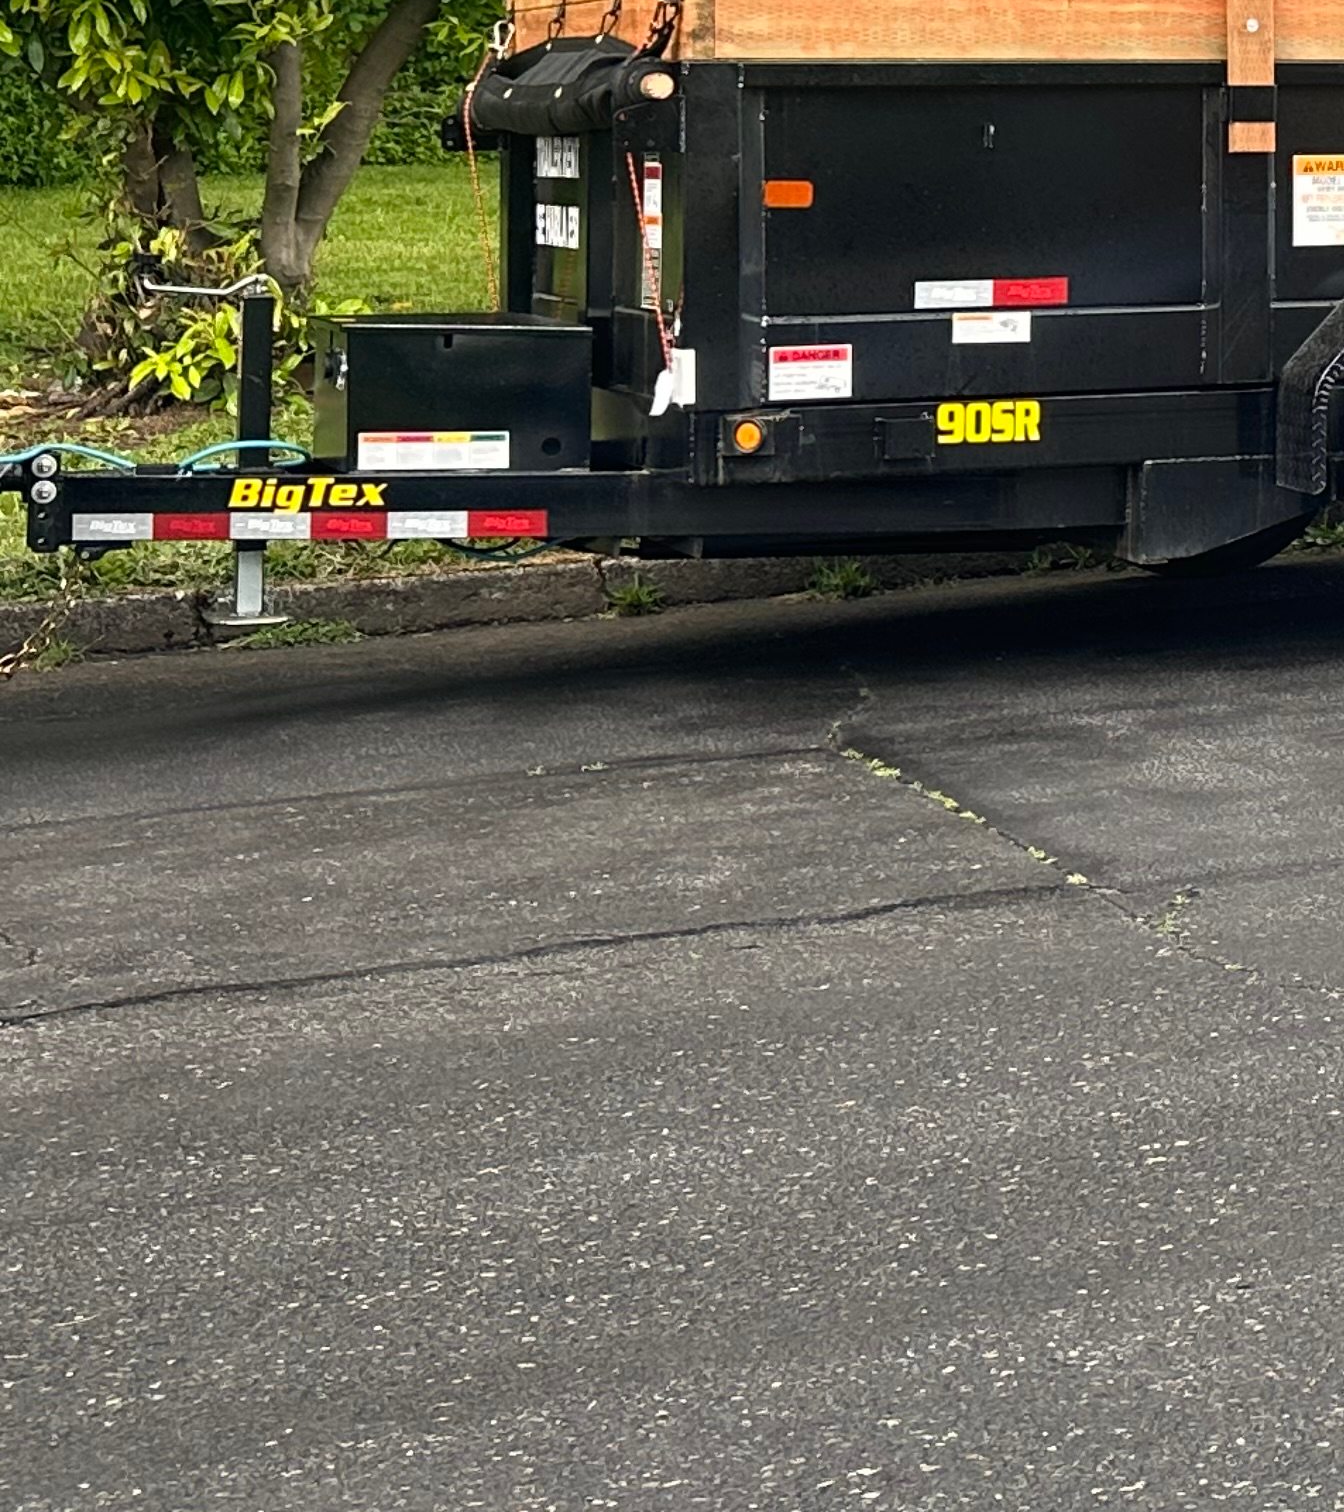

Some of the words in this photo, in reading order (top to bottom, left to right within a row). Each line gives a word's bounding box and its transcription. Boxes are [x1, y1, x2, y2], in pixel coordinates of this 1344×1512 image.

[936, 399, 1041, 444] 90SR
[227, 476, 388, 515] BigTex
[89, 519, 137, 534] BigTex
